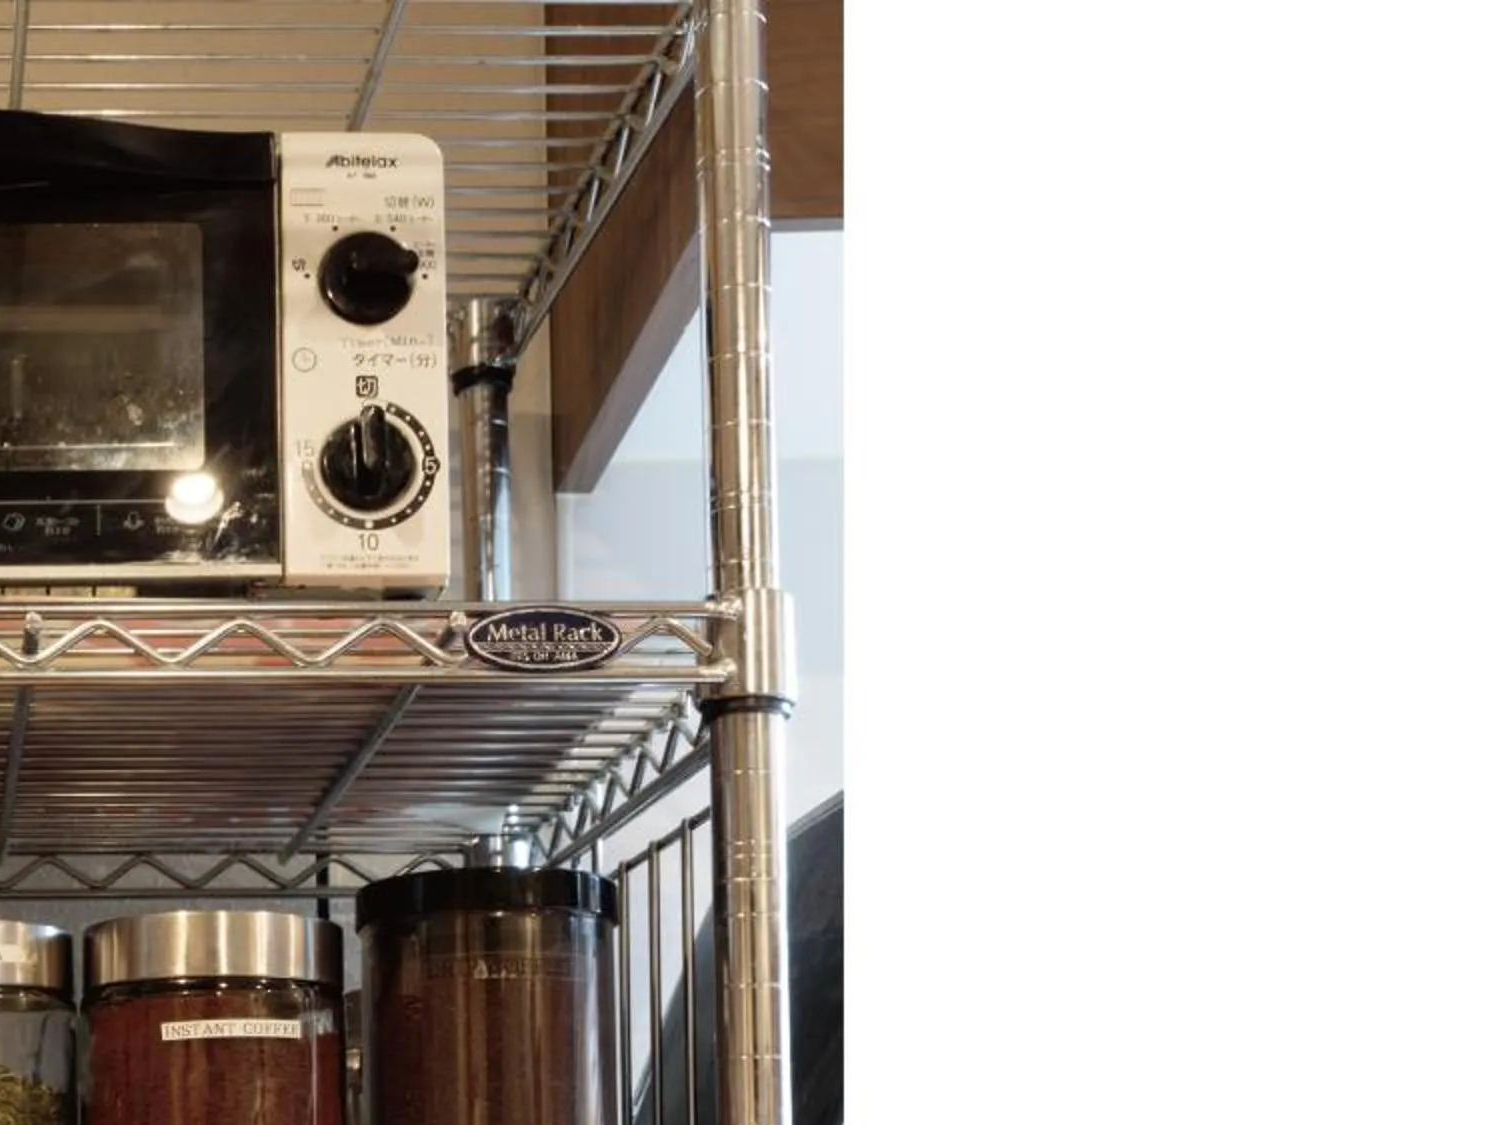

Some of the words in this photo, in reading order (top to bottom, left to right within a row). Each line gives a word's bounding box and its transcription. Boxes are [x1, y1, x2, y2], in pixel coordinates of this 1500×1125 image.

[357, 534, 379, 551] 10
[486, 623, 547, 641] Metal
[553, 621, 603, 641] Rack
[164, 1022, 236, 1039] INSTANT
